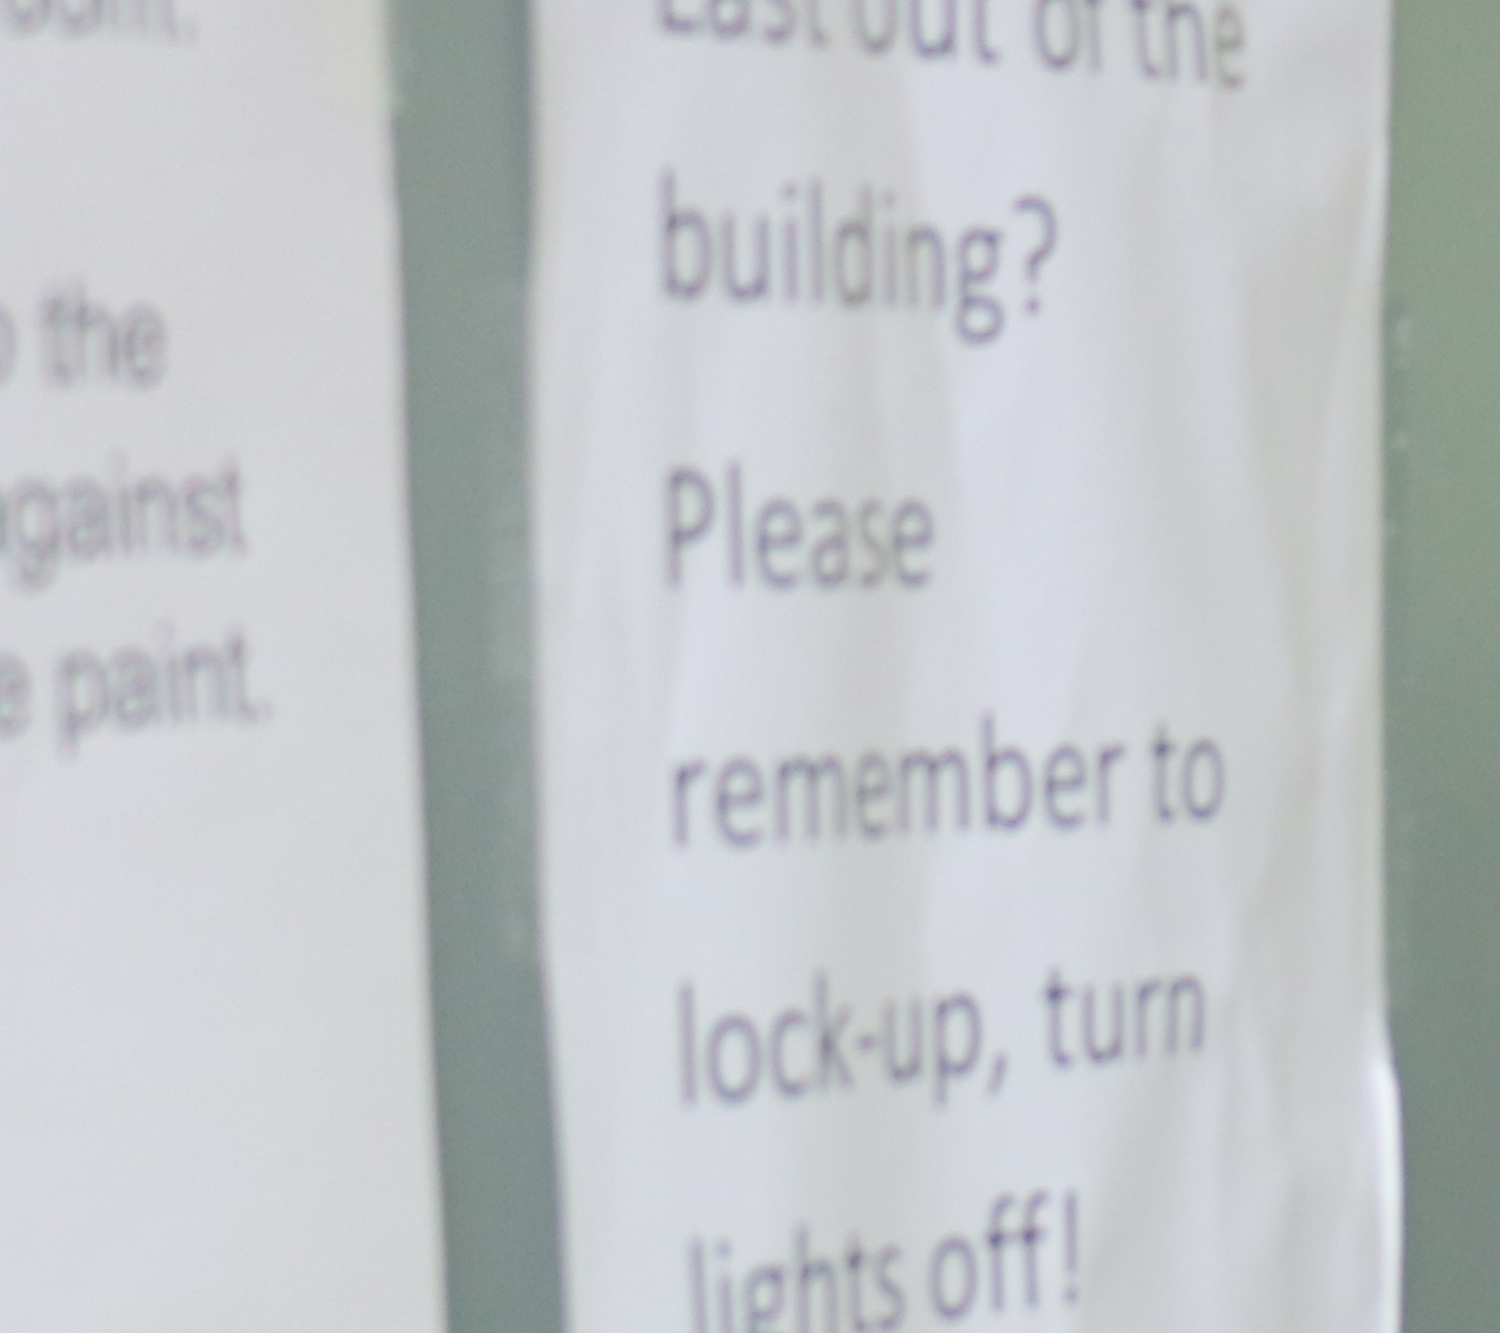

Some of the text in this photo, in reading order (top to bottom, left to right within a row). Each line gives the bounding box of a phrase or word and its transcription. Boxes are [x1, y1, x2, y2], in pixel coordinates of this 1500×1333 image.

[1128, 0, 1246, 91] the
[660, 170, 1059, 346] building?
[39, 278, 168, 391] the
[0, 452, 248, 596] gainst
[662, 460, 935, 592] Please
[56, 620, 273, 758] paint.
[671, 710, 1225, 851] remember to
[678, 967, 1206, 1108] lock-up, turn
[928, 1188, 1079, 1324] off!
